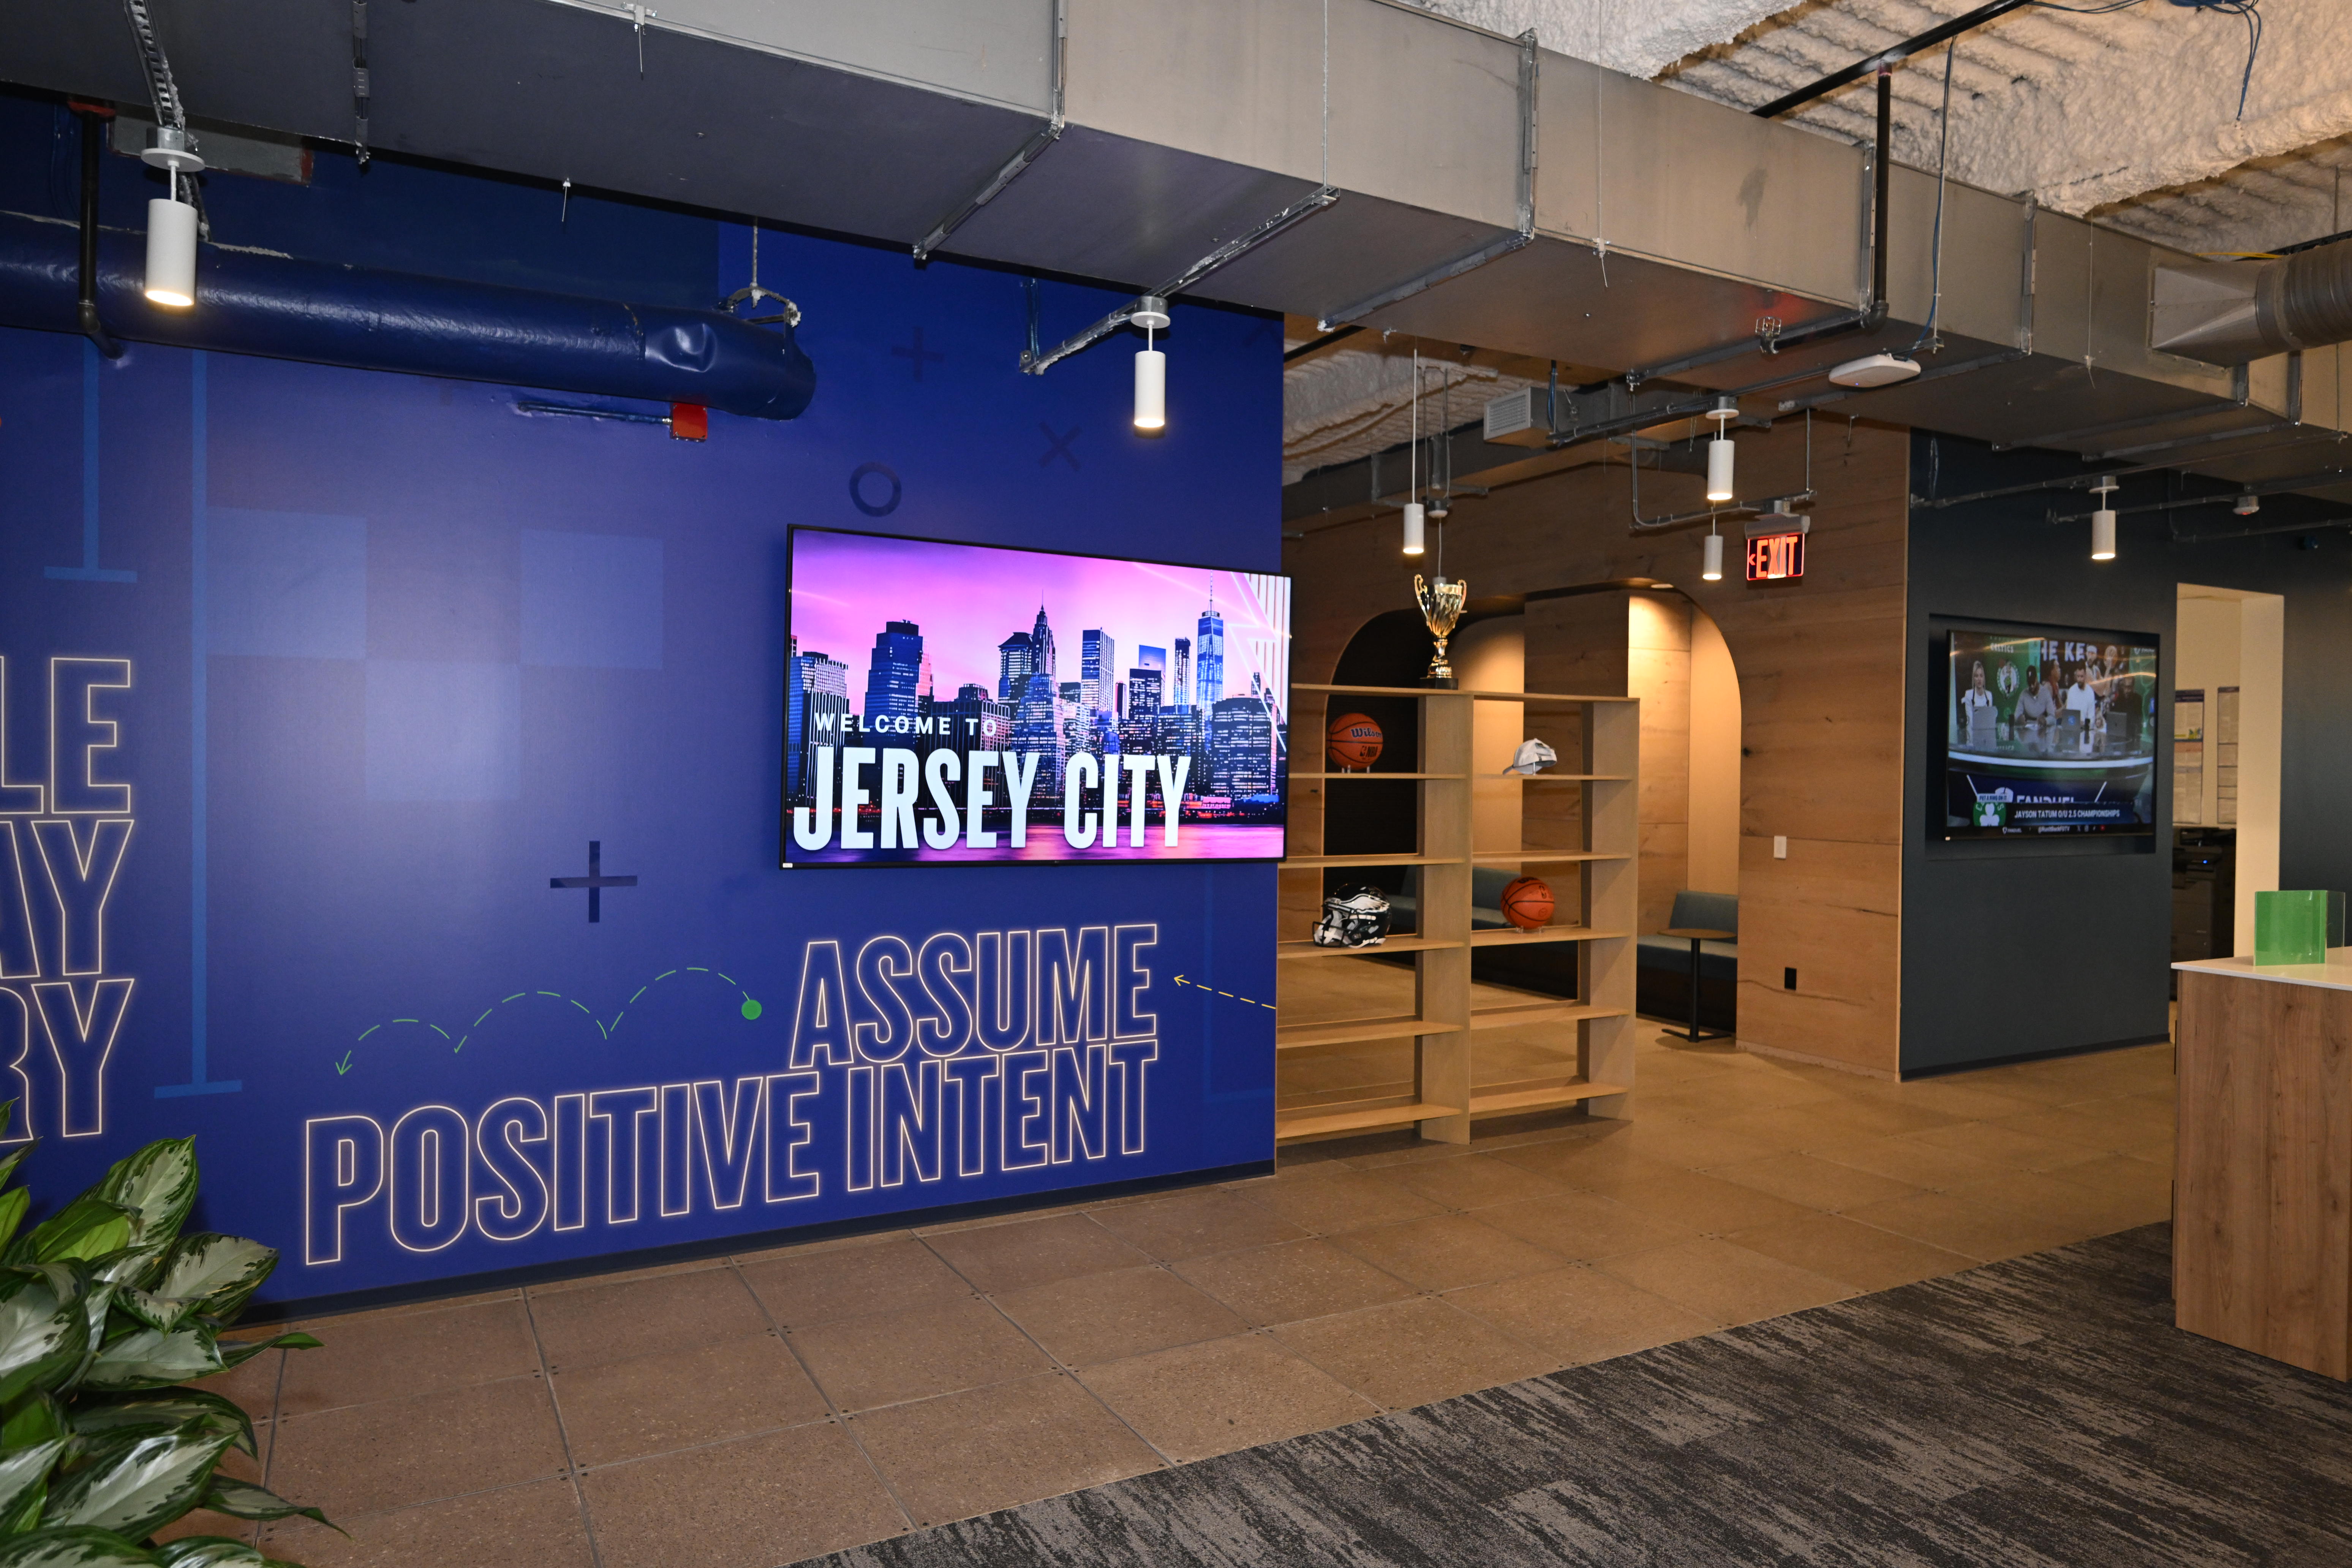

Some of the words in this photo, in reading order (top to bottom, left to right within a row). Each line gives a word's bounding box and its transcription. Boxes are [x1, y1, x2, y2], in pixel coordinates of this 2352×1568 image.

[1756, 536, 1798, 578] EXIT
[816, 713, 952, 736] WELCOME
[965, 718, 997, 737] TO
[793, 746, 1040, 850] JERSEY
[1064, 752, 1191, 849] CITY
[2014, 810, 2037, 819] JAYSON
[2037, 810, 2057, 818] TATUM
[2068, 809, 2077, 818] 2.5
[2077, 809, 2120, 818] CHAMPIONSHIPS
[790, 924, 1157, 1069] ASSUME
[305, 1071, 820, 1266] POSITIVE
[846, 1038, 1158, 1192] INTENT
